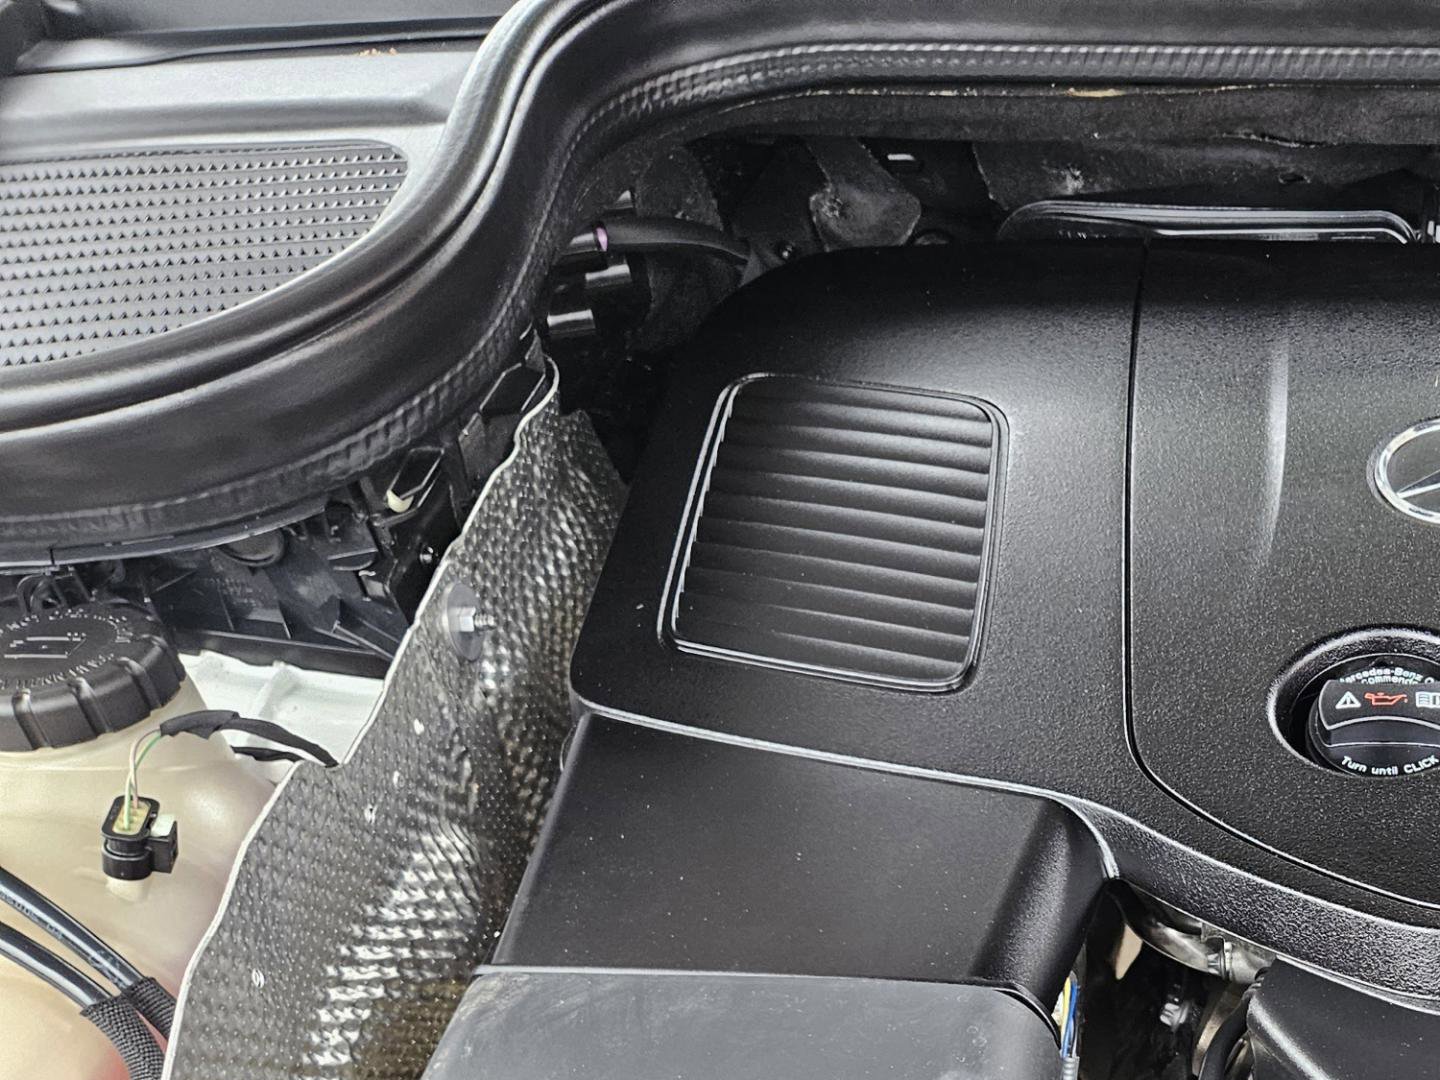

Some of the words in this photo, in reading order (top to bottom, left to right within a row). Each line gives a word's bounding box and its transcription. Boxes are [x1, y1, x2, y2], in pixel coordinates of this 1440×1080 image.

[1341, 755, 1367, 773] Turn
[1371, 765, 1398, 776] until
[1403, 755, 1440, 774] CLICK
